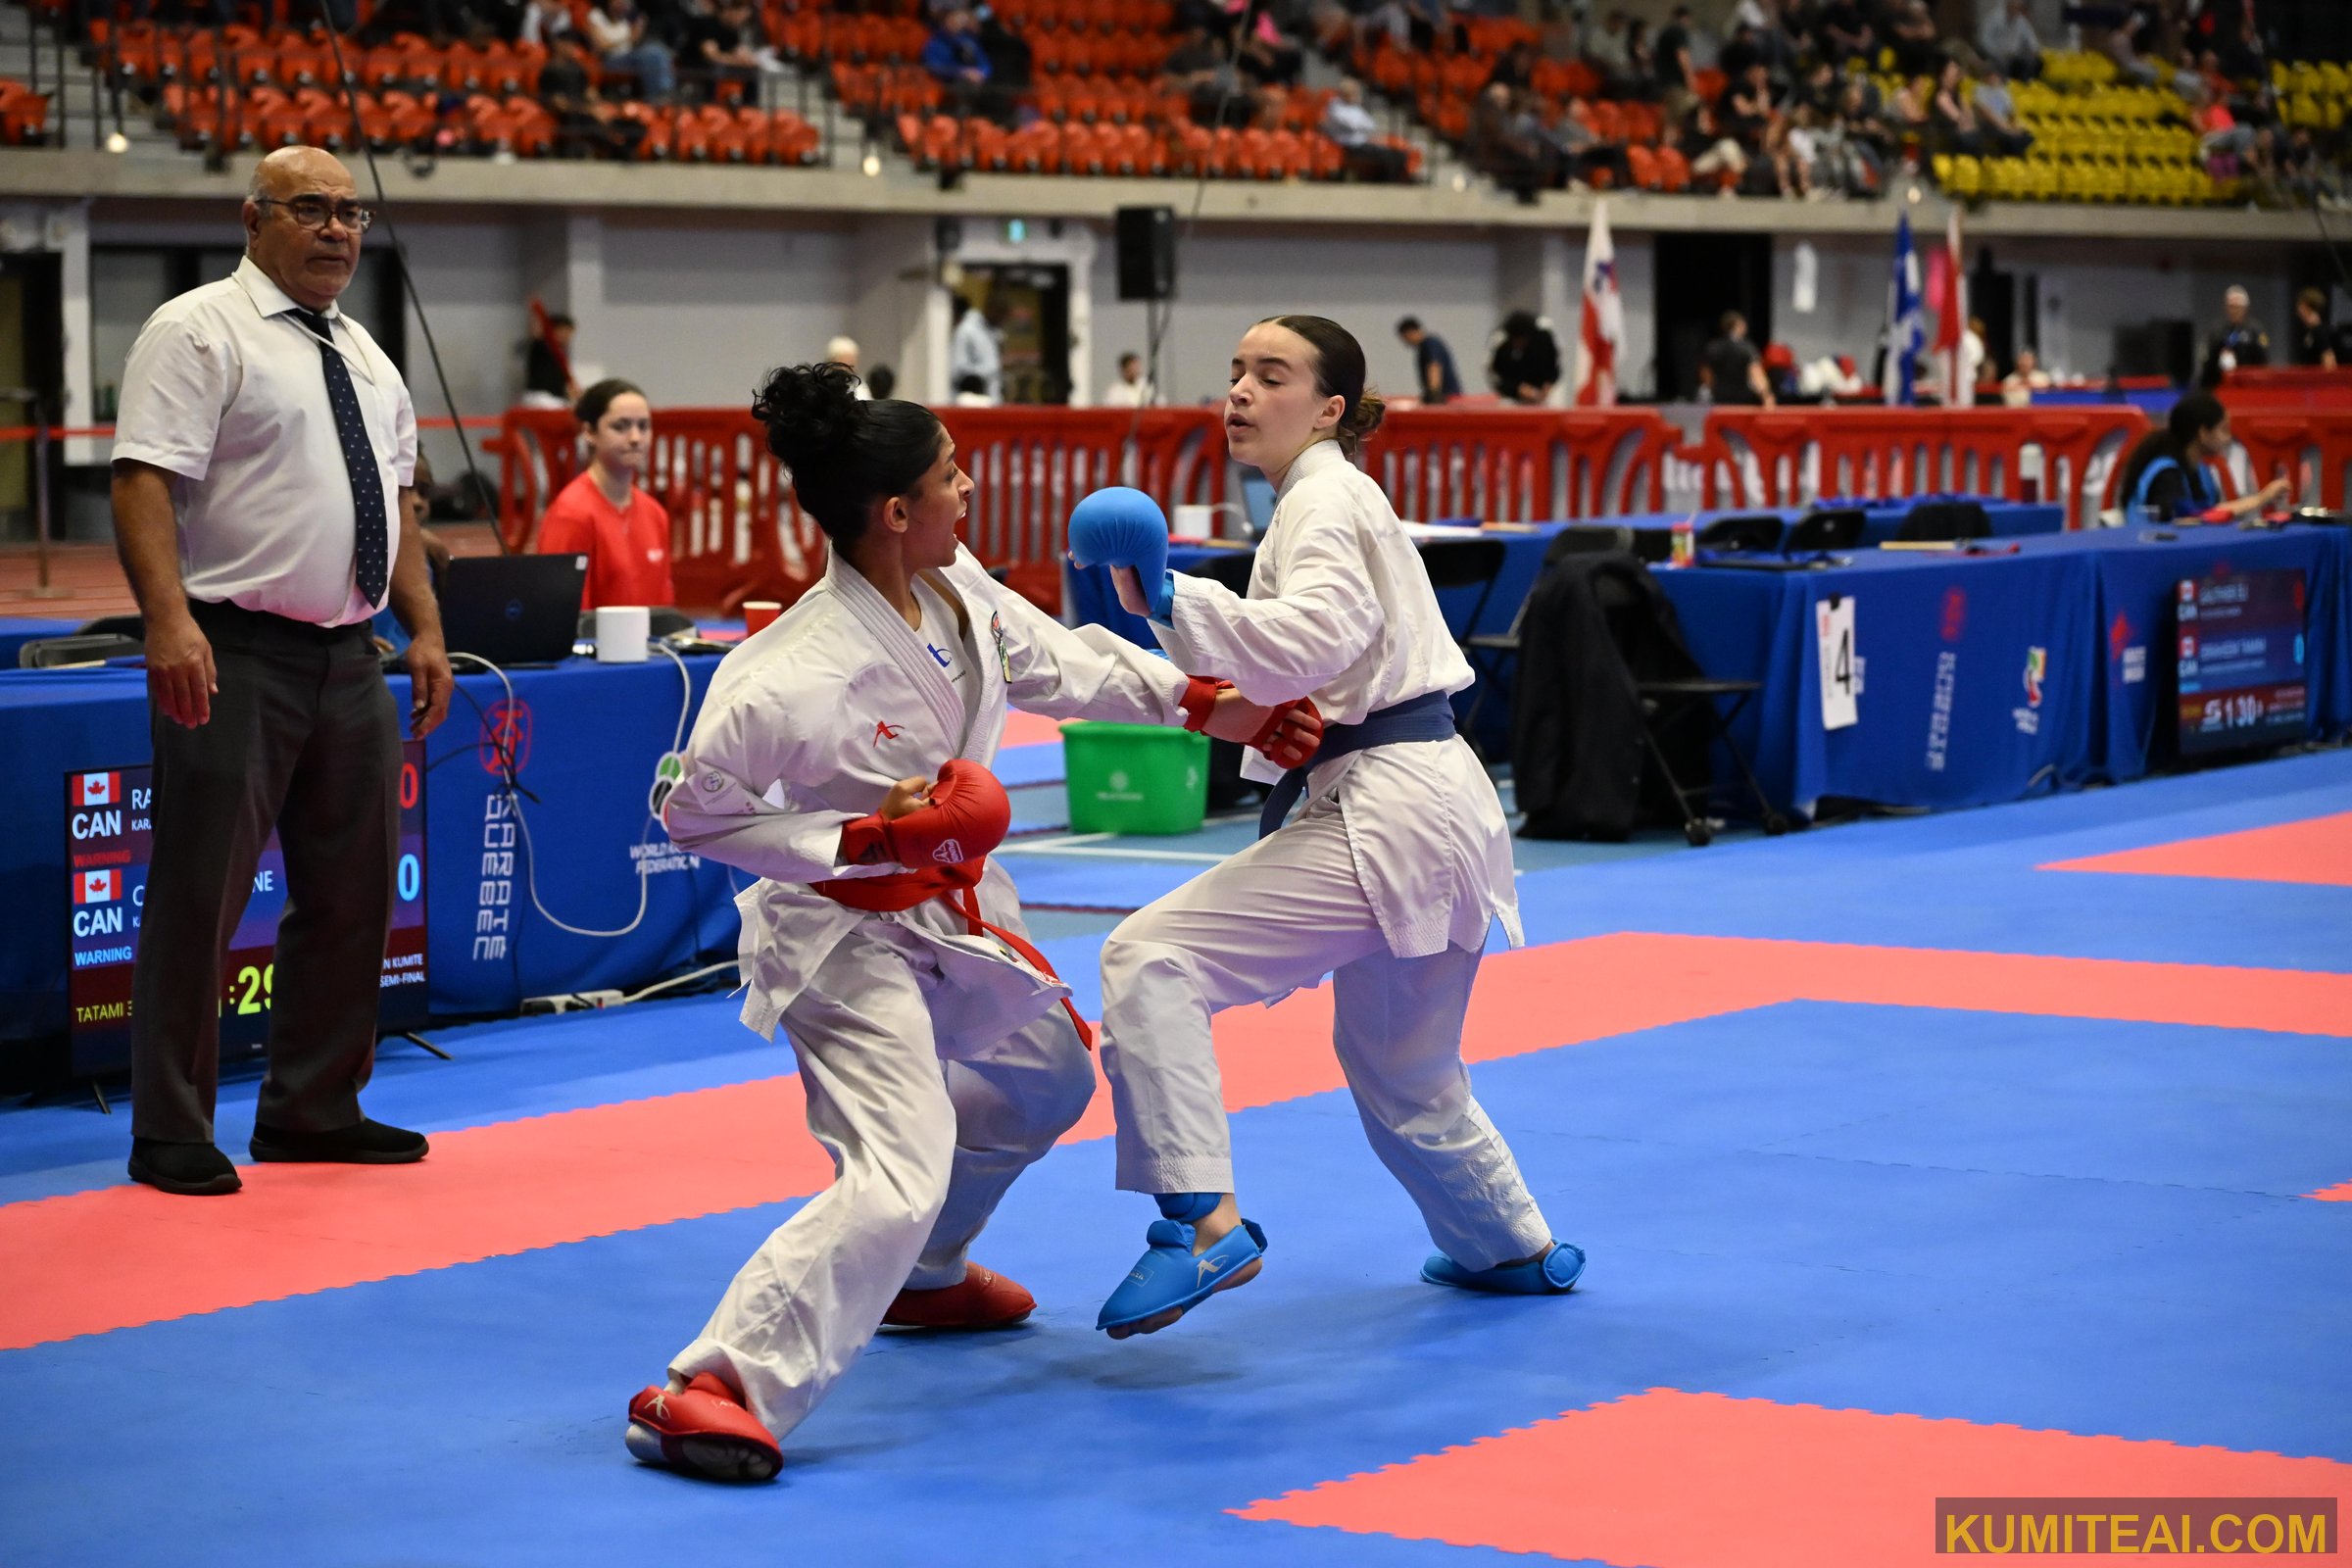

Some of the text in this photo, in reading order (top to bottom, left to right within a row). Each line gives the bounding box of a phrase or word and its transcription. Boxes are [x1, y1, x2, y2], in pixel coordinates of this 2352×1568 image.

[1835, 628, 1851, 695] 4
[400, 761, 418, 809] 0
[72, 809, 122, 840] CAN
[398, 854, 420, 902] 0
[74, 906, 122, 938] CAN
[74, 946, 132, 967] WARNING
[392, 953, 424, 968] KUMITE
[379, 970, 425, 988] SEMI-FINAL
[75, 1003, 124, 1023] TATAMI
